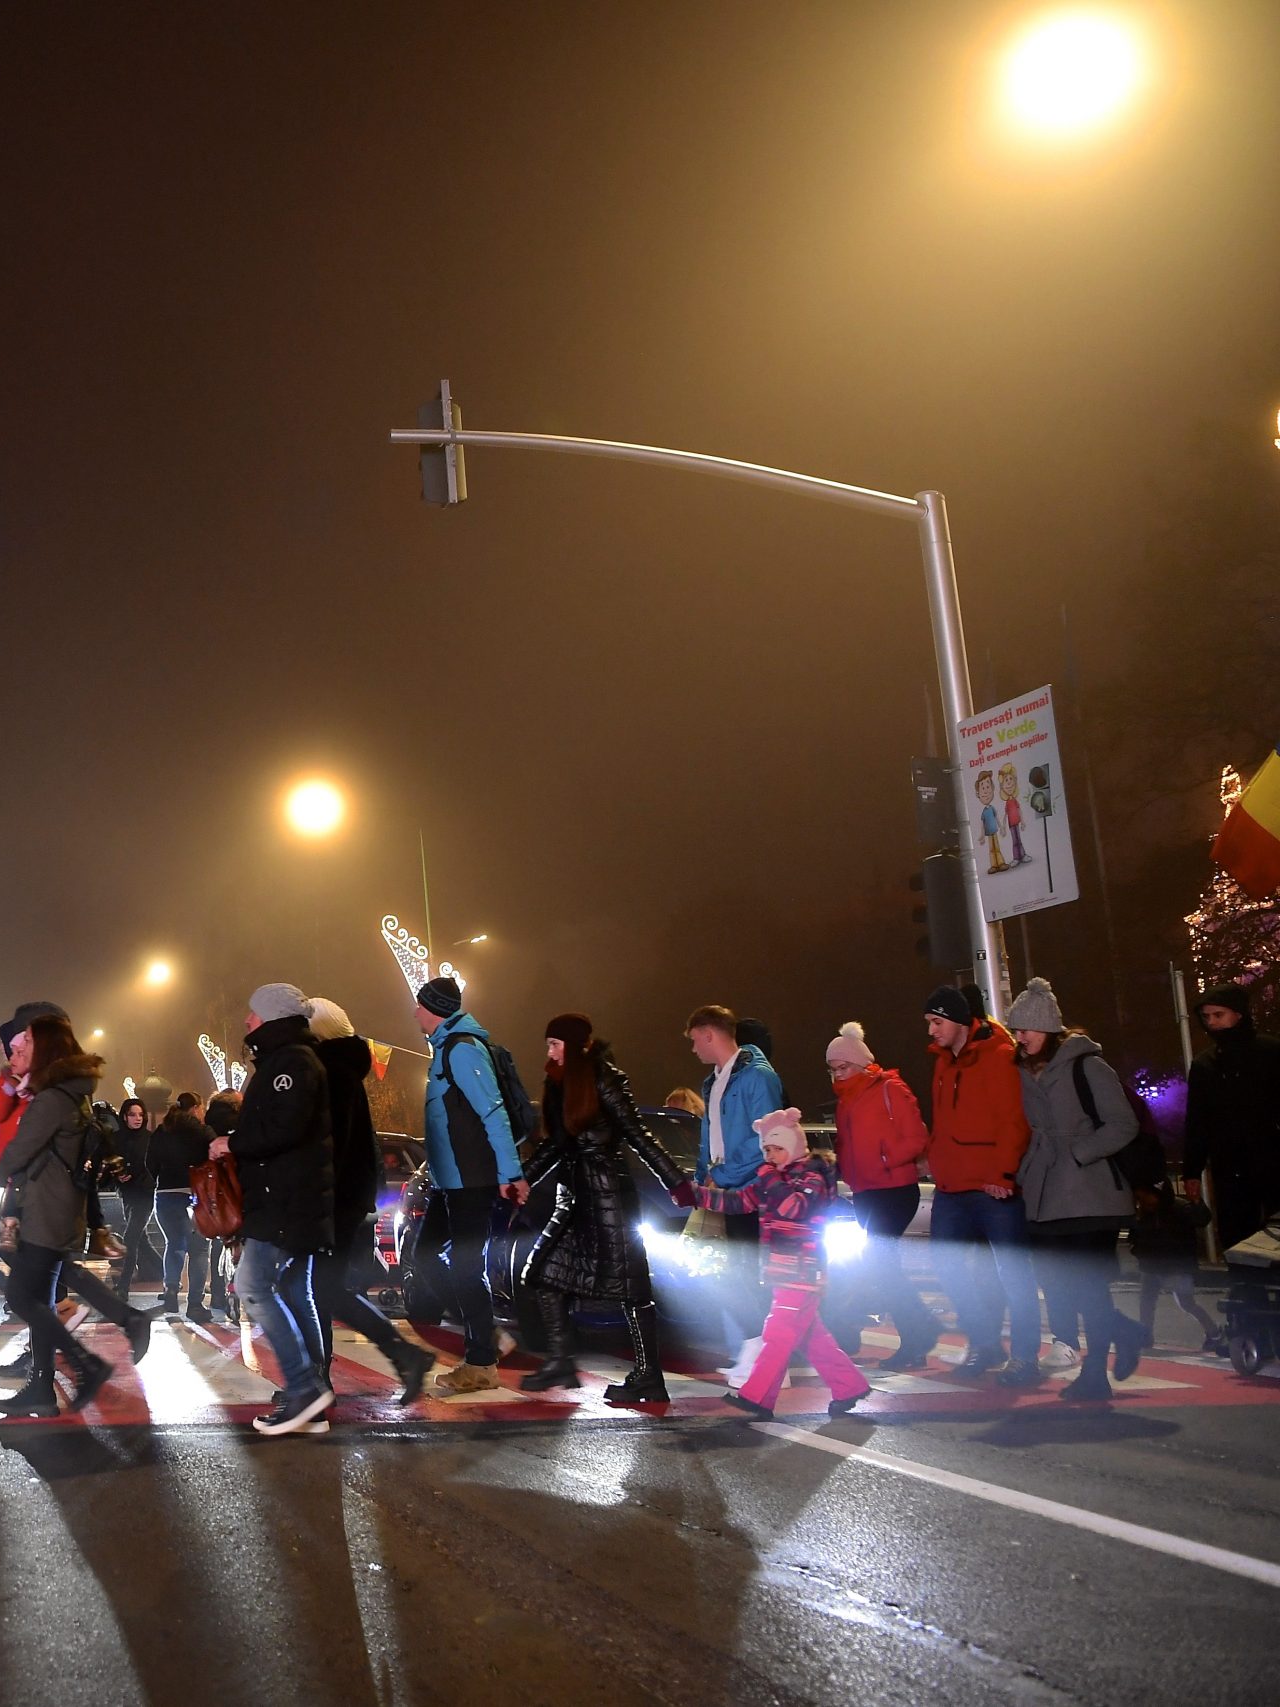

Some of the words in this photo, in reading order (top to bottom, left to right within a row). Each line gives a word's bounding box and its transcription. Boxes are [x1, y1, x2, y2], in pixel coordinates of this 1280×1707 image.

[1016, 693, 1049, 716] numai
[977, 737, 993, 755] pe
[996, 719, 1037, 743] Verde
[986, 744, 1018, 762] exemplu
